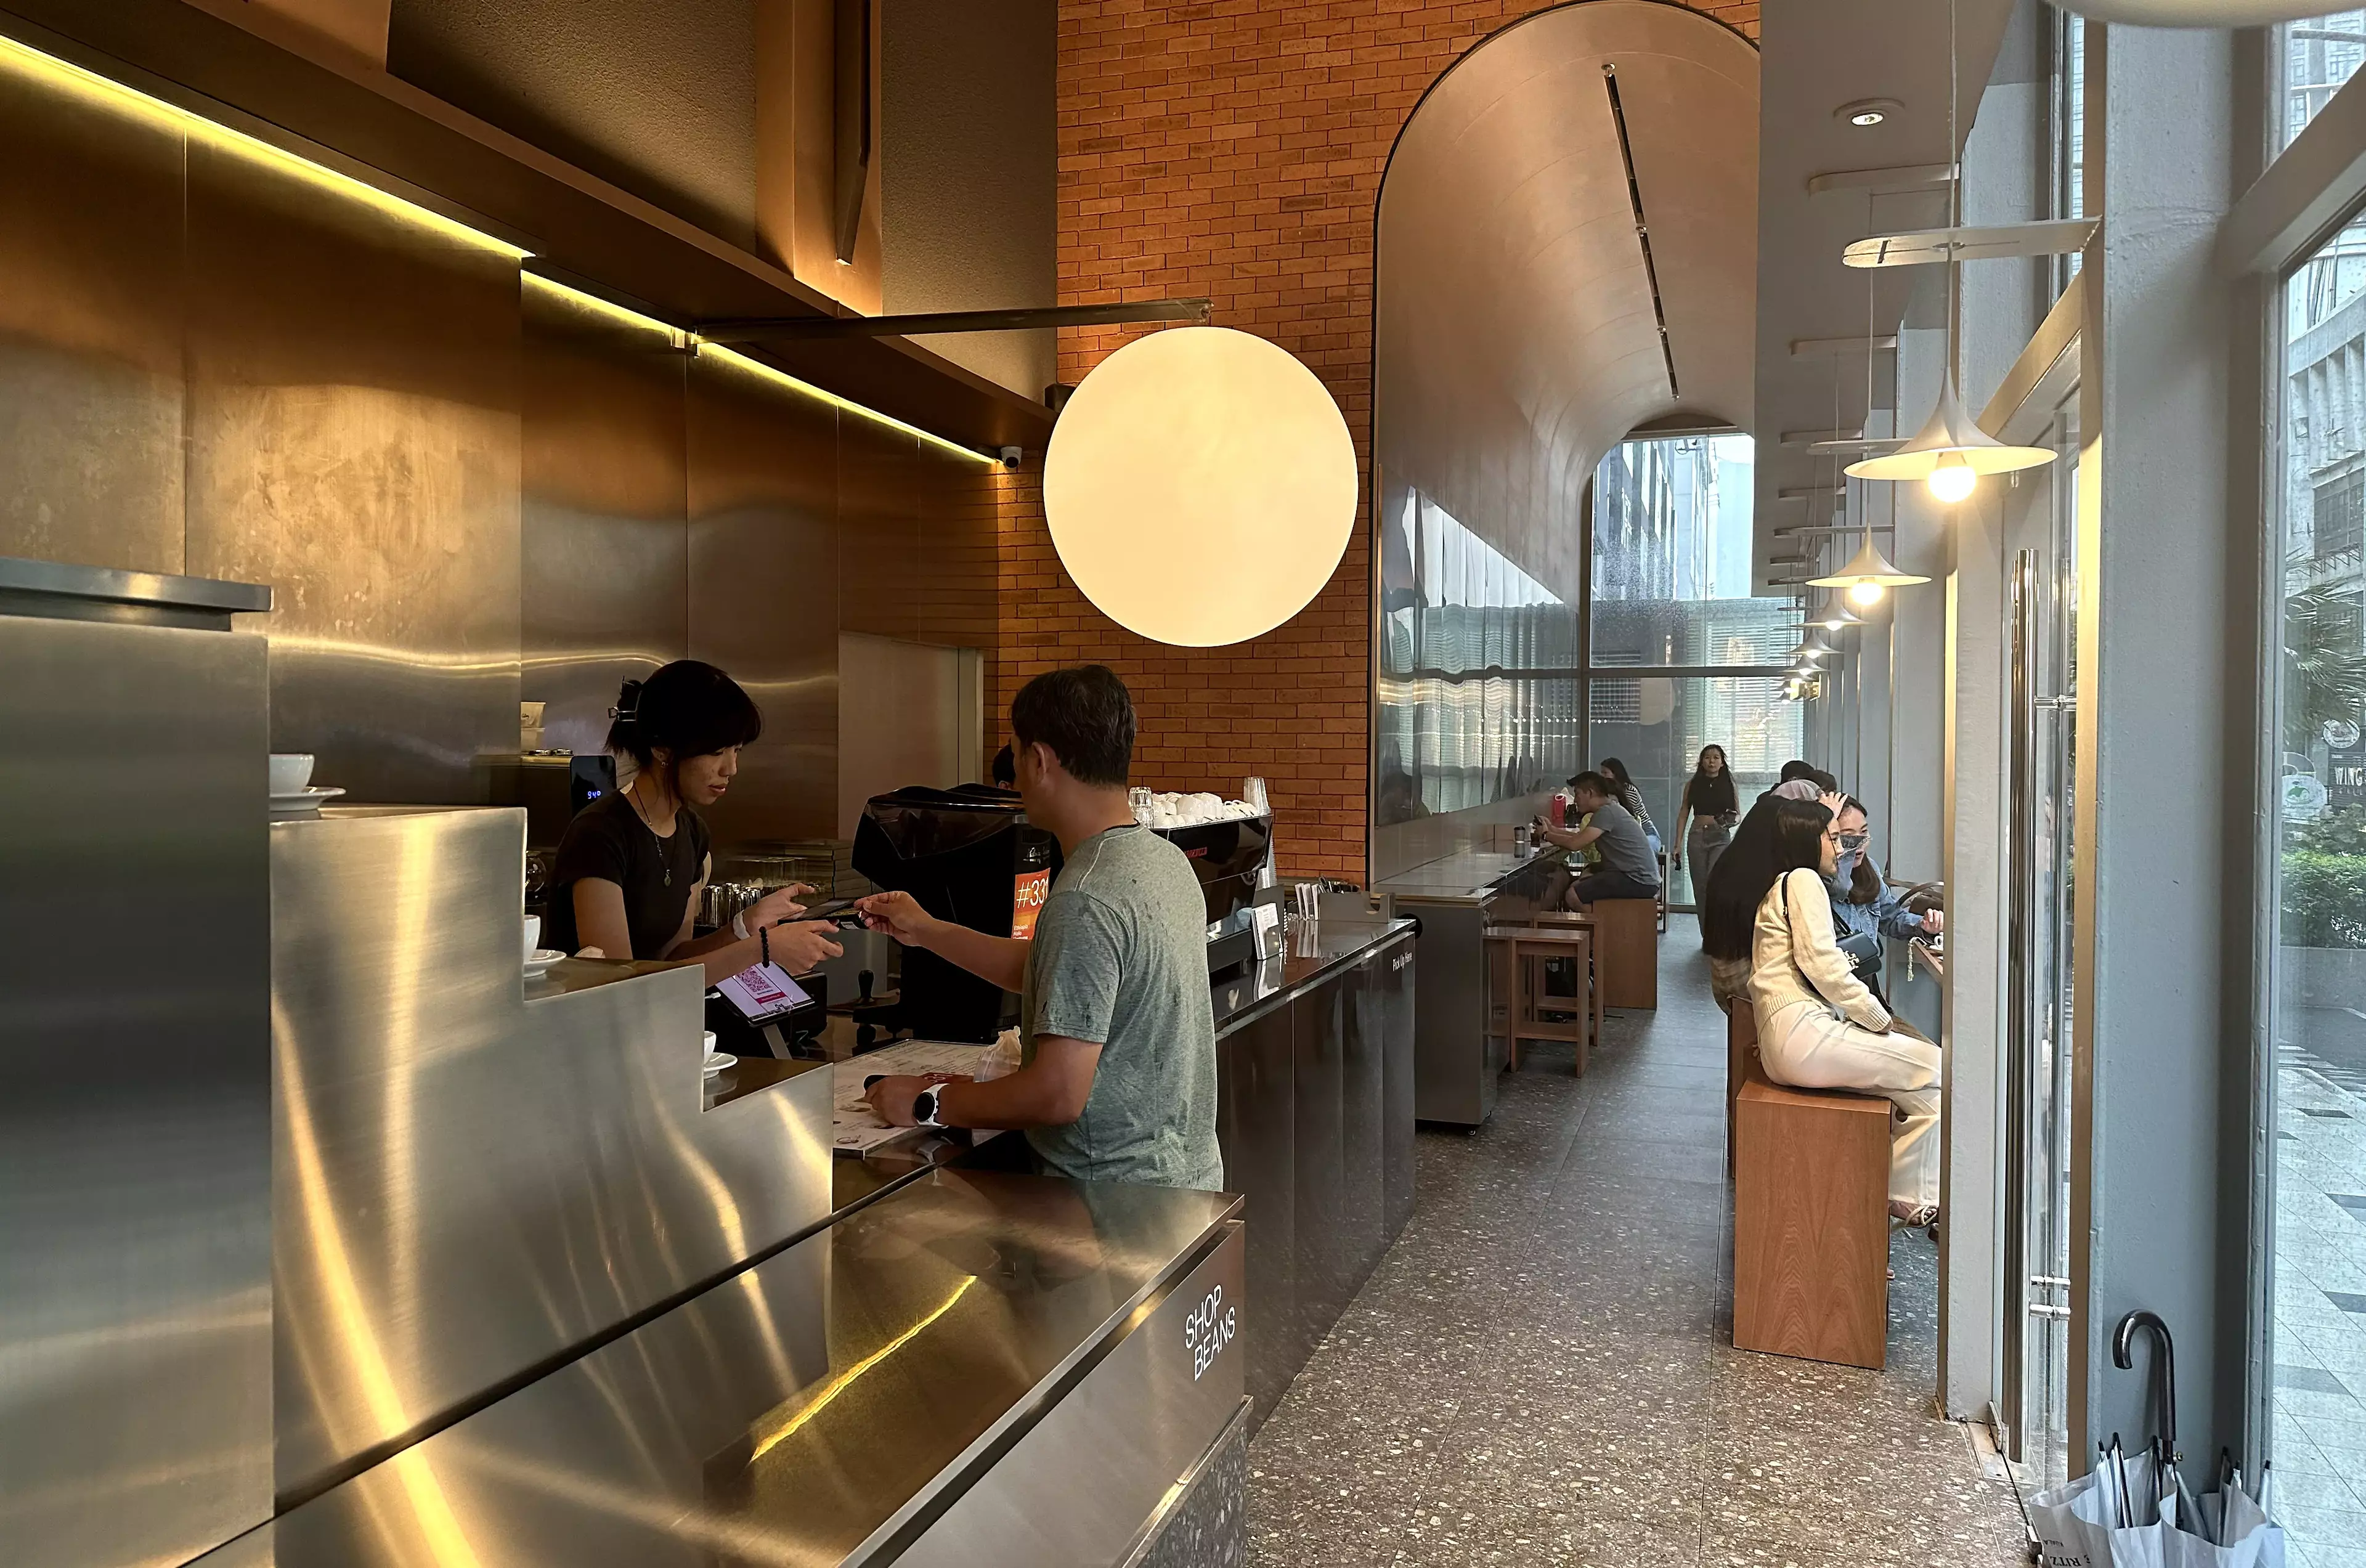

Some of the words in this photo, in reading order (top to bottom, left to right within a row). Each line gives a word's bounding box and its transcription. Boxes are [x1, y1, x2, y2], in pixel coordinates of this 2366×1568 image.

[2334, 766, 2366, 786] WING
[1392, 956, 1400, 972] Pick
[1400, 954, 1405, 969] Up
[1185, 1284, 1222, 1349] SHOP
[1193, 1306, 1236, 1381] BEANS
[2049, 1556, 2082, 1567] RITZ
